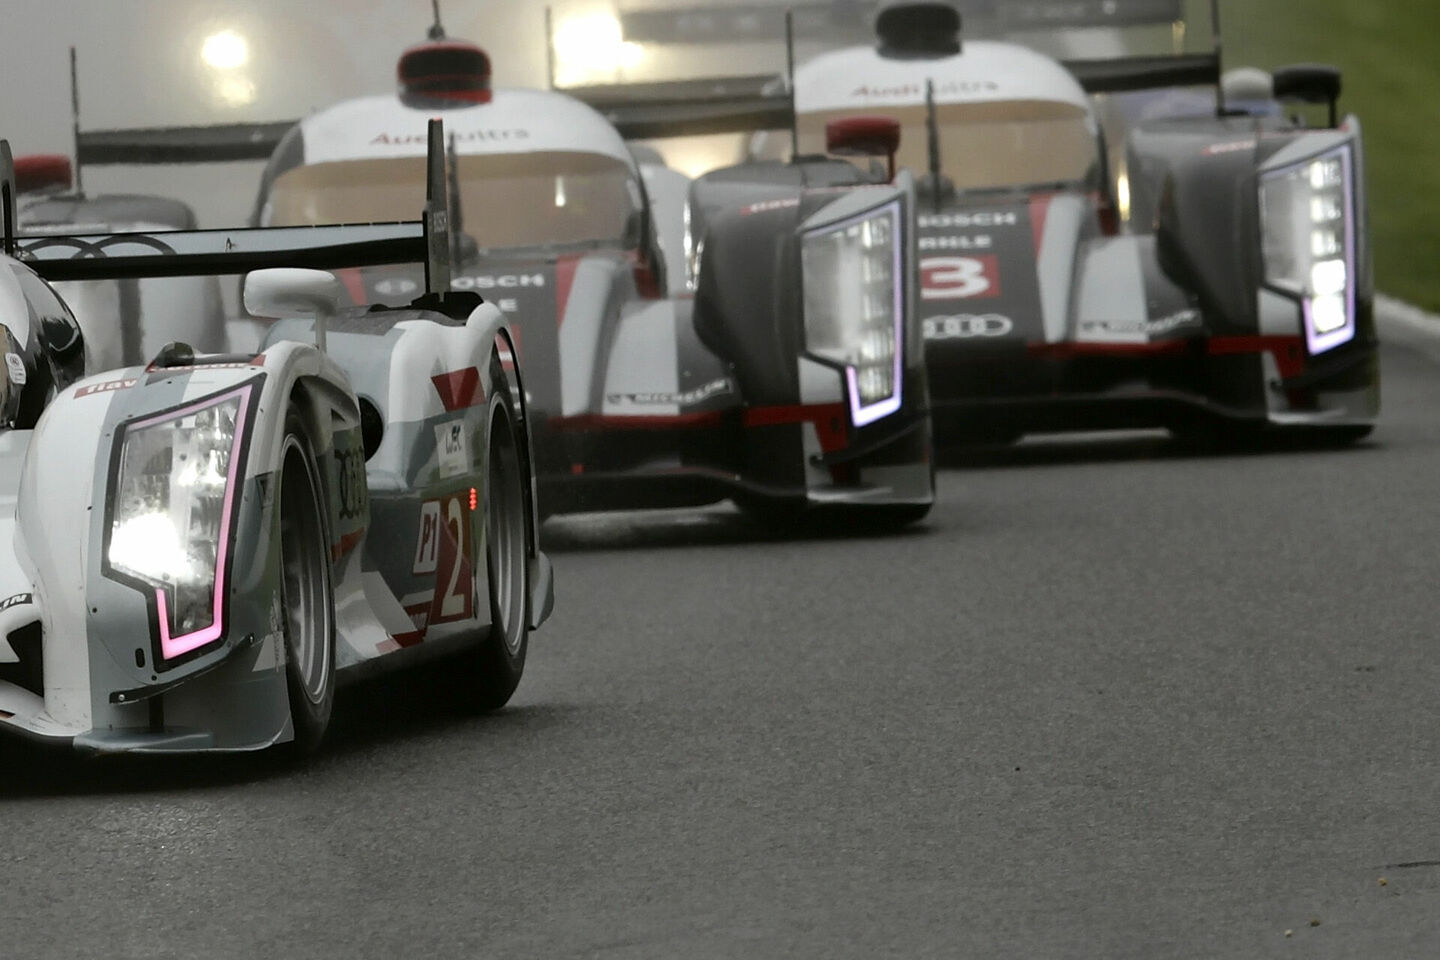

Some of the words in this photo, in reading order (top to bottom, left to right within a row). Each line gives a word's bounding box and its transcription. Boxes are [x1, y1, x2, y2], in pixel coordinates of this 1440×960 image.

[449, 272, 545, 290] OSCH
[920, 256, 990, 300] 3
[418, 512, 438, 564] P1
[440, 496, 466, 617] 2
